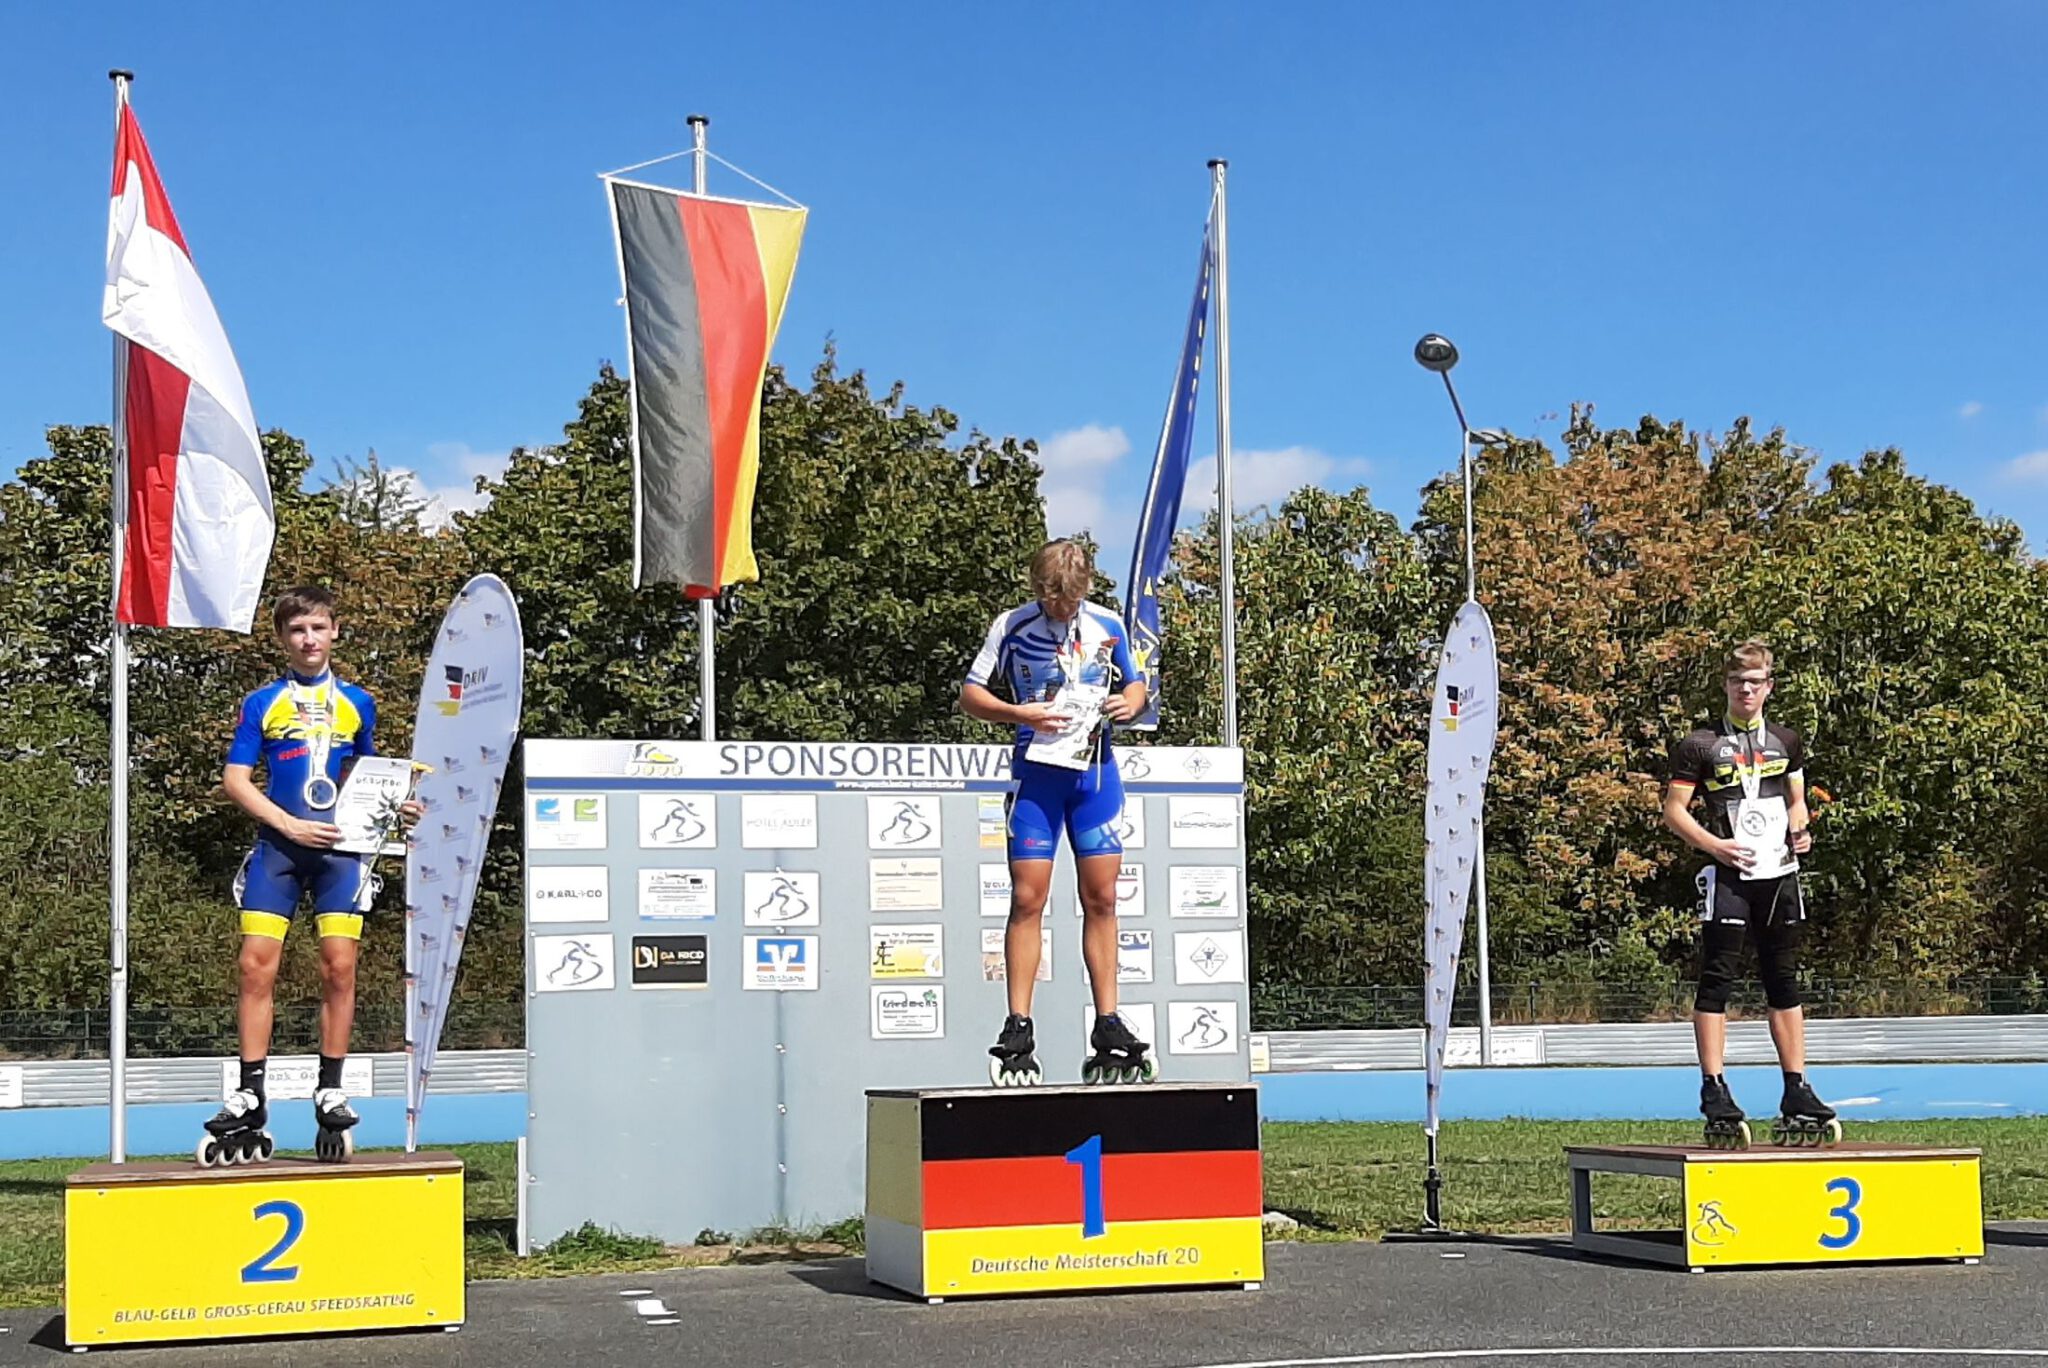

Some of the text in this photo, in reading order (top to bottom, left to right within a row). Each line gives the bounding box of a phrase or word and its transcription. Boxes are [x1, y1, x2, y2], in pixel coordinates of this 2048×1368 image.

[719, 744, 1013, 778] SPONSORENWA
[1065, 1134, 1106, 1239] 1
[1817, 1176, 1862, 1249] 3
[240, 1199, 306, 1283] 2
[971, 1247, 1199, 1274] Deutsche Meisterschaft 20
[114, 1294, 415, 1323] BLAU-GELB GROSS-GERAU SPEEDSKATING
